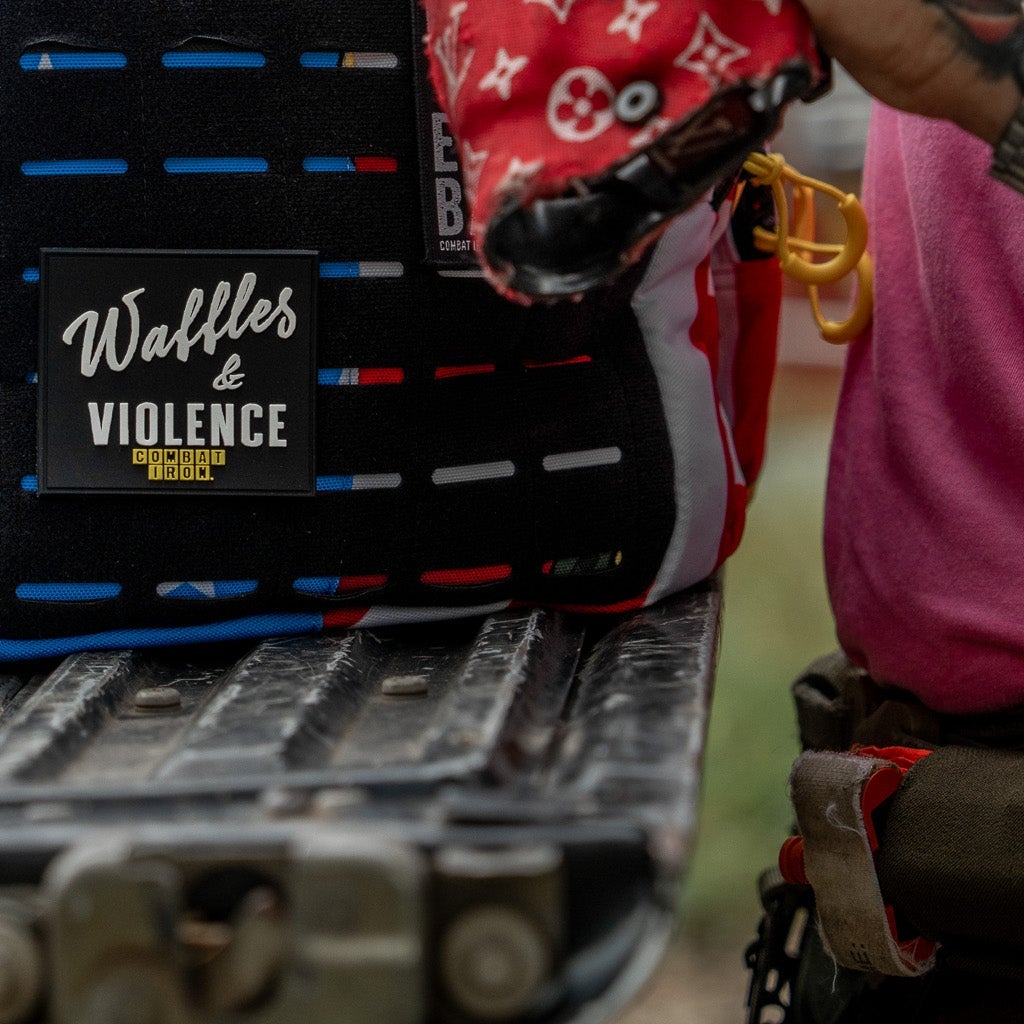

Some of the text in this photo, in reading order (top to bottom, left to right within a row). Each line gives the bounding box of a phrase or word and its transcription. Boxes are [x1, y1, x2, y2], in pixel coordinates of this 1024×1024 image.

[431, 112, 459, 172] E
[435, 177, 465, 236] B
[439, 240, 471, 251] COMBAT
[62, 272, 297, 378] Waffles
[212, 353, 245, 390] &
[87, 402, 288, 447] VIOLENCE
[134, 450, 223, 464] COMBAT
